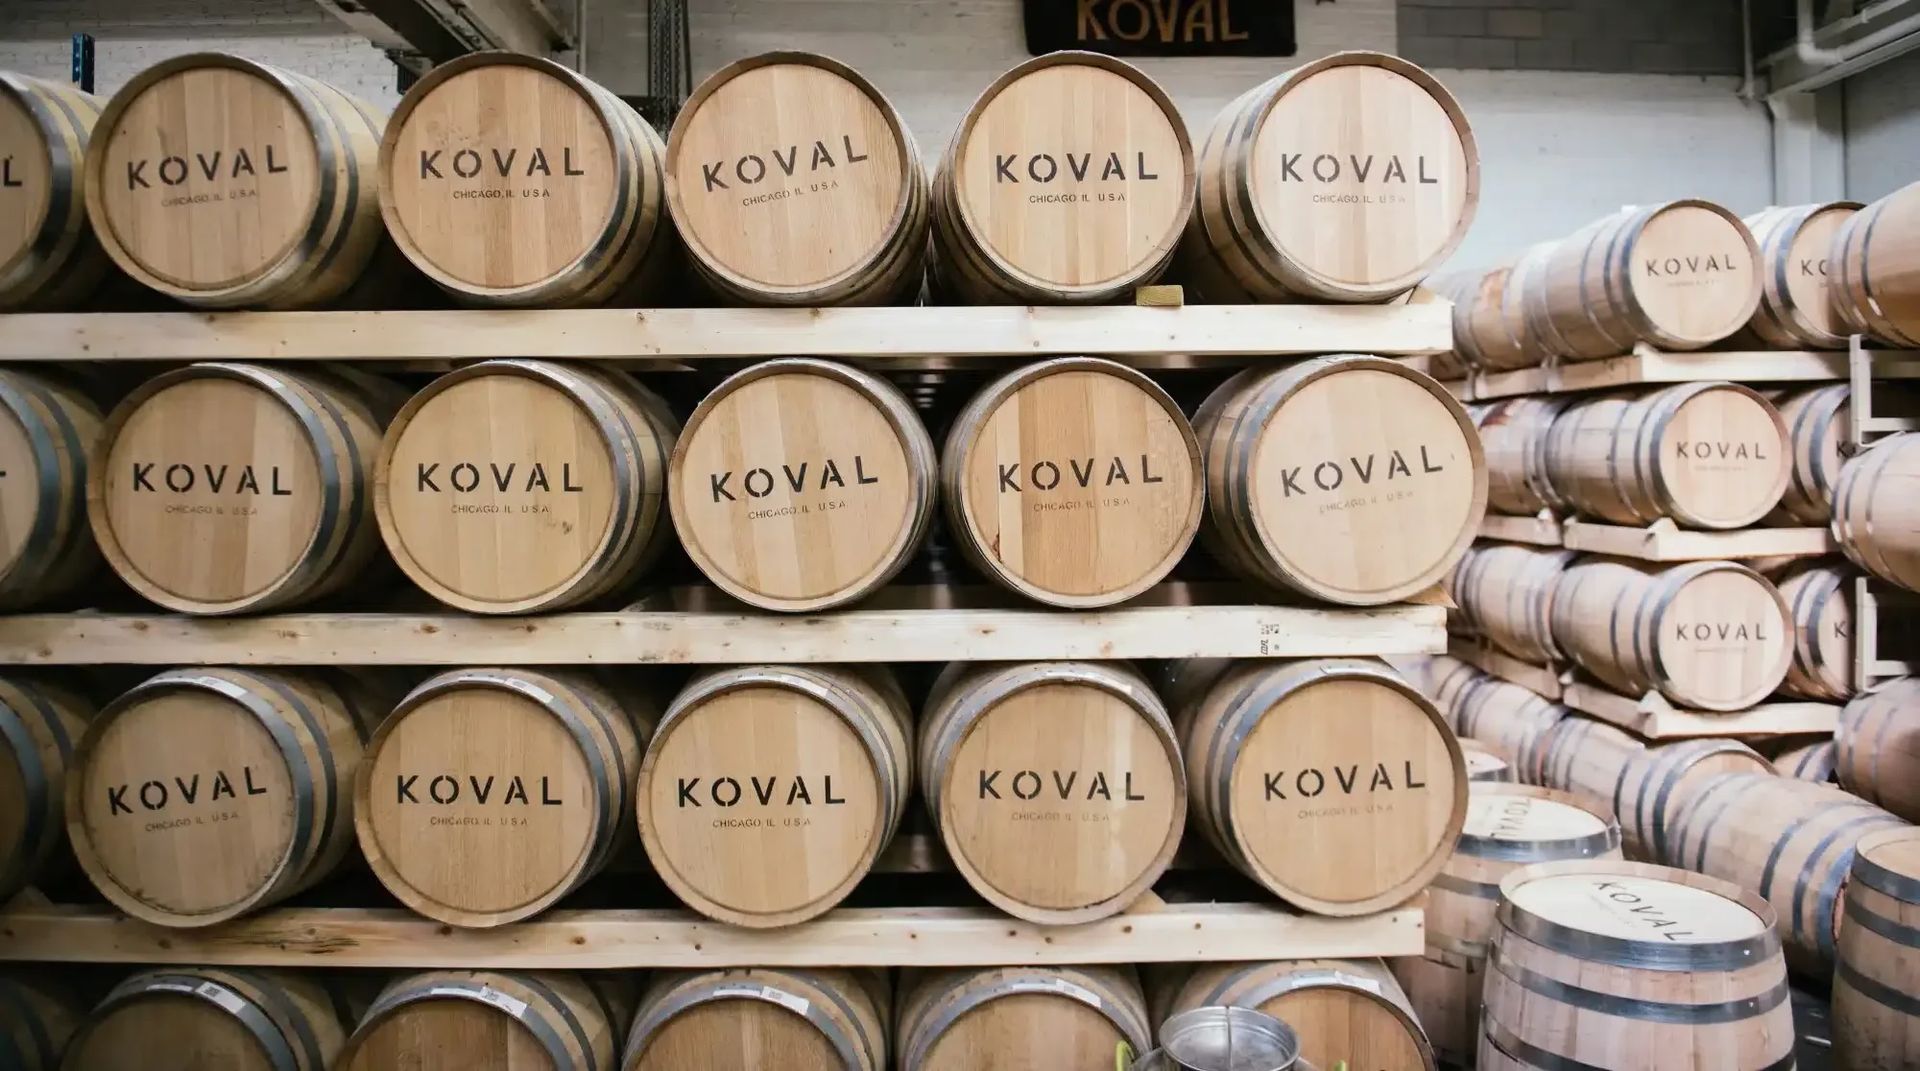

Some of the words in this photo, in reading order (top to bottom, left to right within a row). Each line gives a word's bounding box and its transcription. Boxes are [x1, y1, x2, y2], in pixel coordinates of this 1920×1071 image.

[1076, 0, 1249, 42] KOVAL
[127, 144, 287, 190] KOVAL
[421, 147, 584, 179] KOVAL
[702, 135, 868, 192] KOVAL
[996, 152, 1158, 183] KOVAL
[1281, 154, 1437, 183] KOVAL
[1646, 254, 1736, 276] KOVAL
[1676, 442, 1767, 460] KOVAL
[133, 463, 292, 495] KOVAL
[418, 463, 583, 492] KOVAL
[711, 455, 878, 503] KOVAL
[999, 454, 1163, 493] KOVAL
[1281, 445, 1443, 497] KOVAL
[1676, 623, 1767, 640] KOVAL
[108, 767, 267, 815] KOVAL
[397, 775, 562, 805] KOVAL
[678, 775, 845, 807] KOVAL
[979, 770, 1144, 800] KOVAL
[1264, 761, 1425, 801] KOVAL
[1593, 880, 1694, 941] KOVAL
